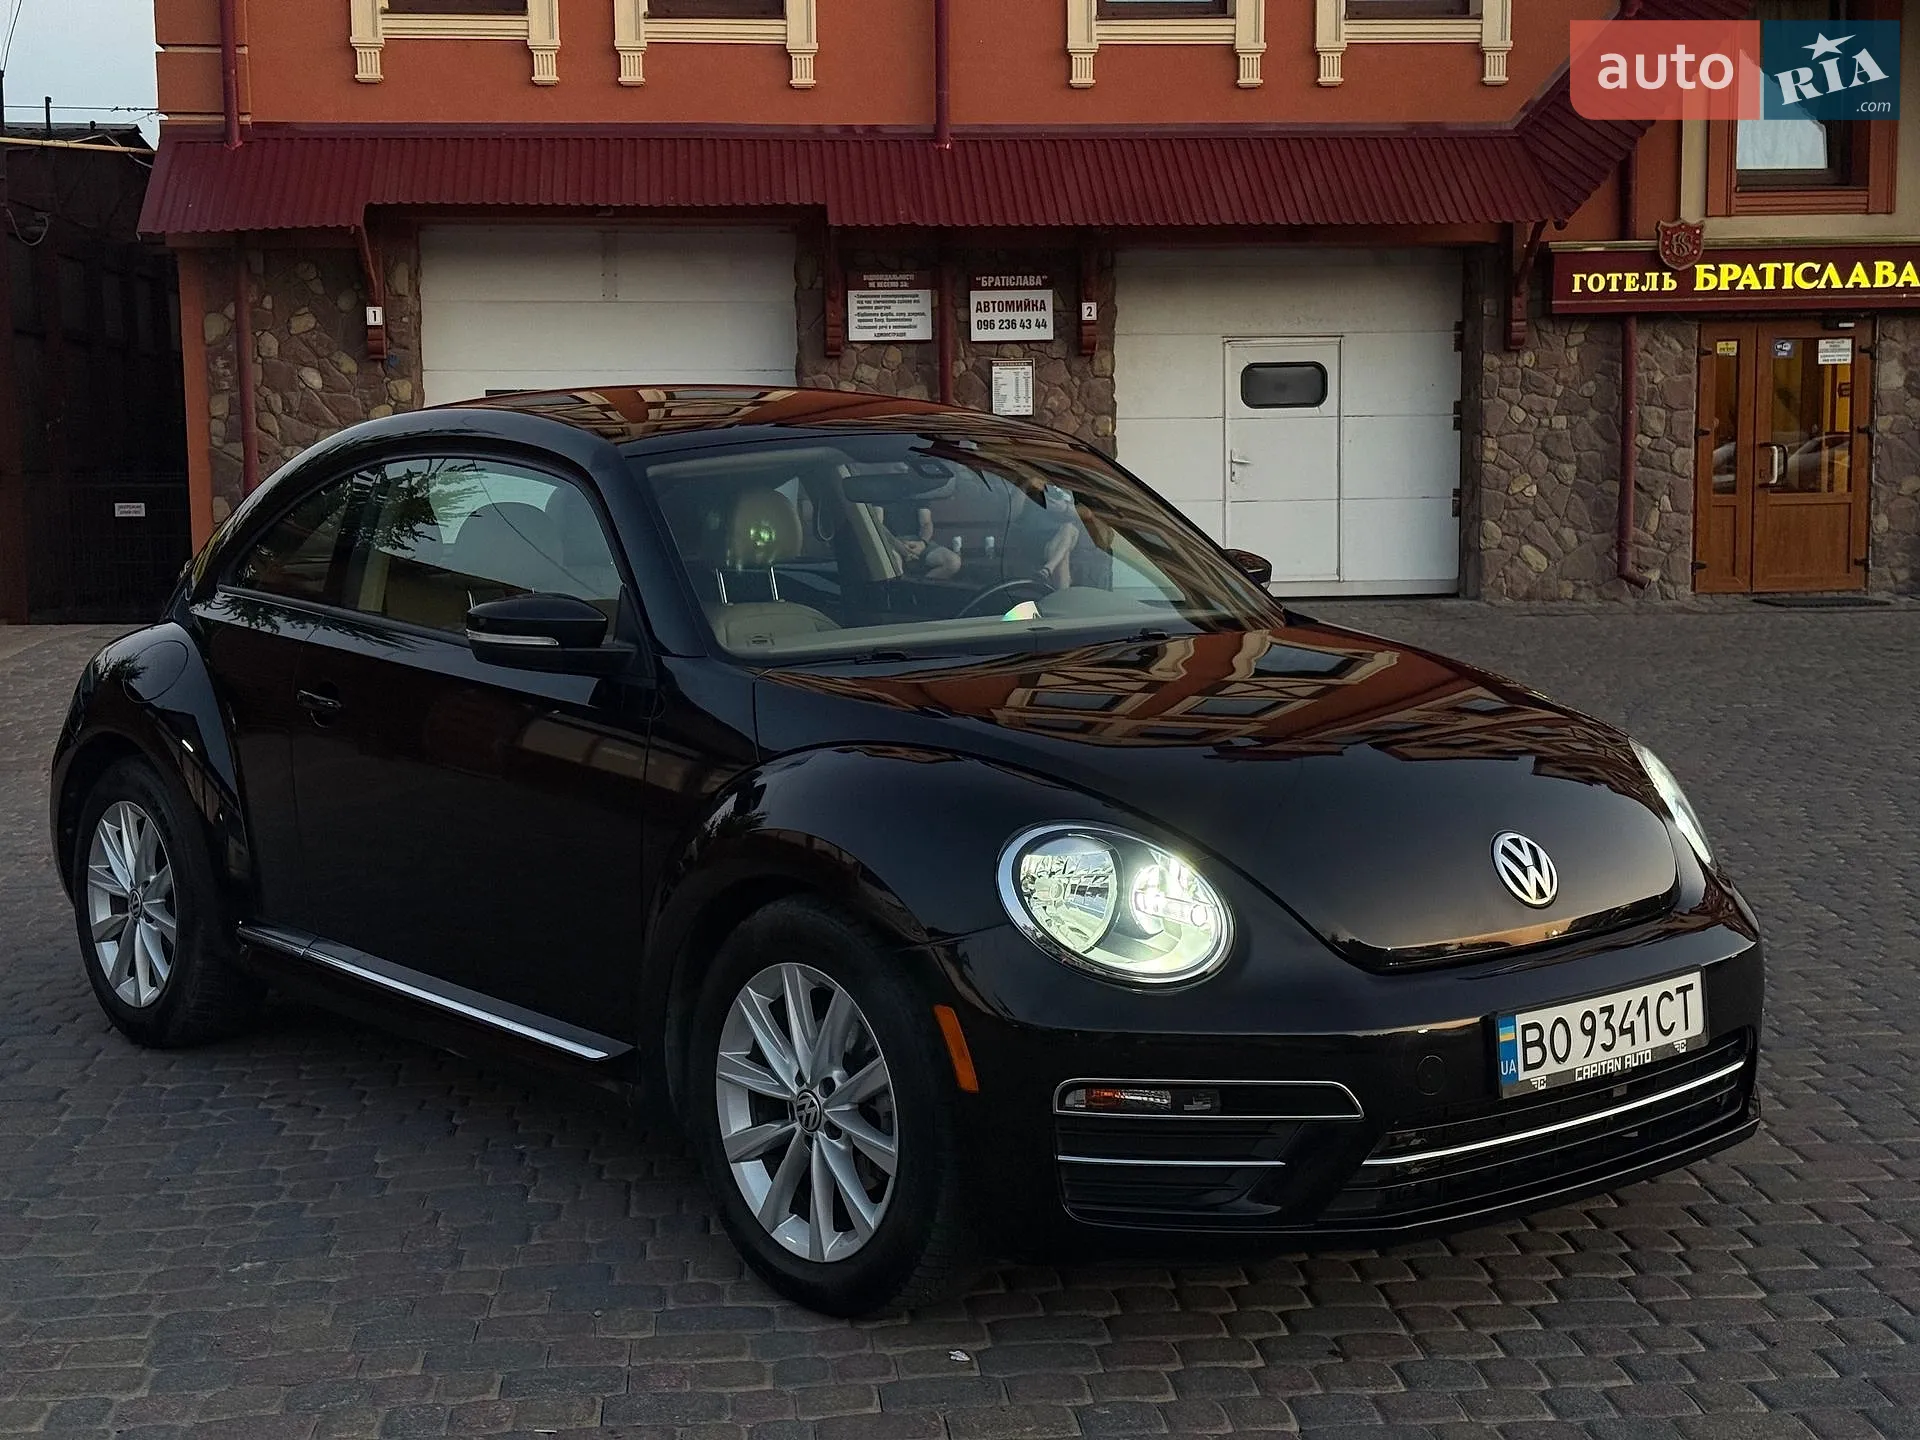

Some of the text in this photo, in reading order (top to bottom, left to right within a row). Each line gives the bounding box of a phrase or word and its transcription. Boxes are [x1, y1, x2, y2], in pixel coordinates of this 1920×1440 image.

[1571, 260, 1920, 293] ГОТЕЛЬ БРАТІСЛАВА
[975, 298, 1047, 313] АВТОМИЙКА
[1086, 306, 1093, 317] 2
[976, 318, 1047, 330] 096 236 43 44
[1501, 1059, 1517, 1076] UA
[1575, 1049, 1652, 1081] CAPITAN AUTO
